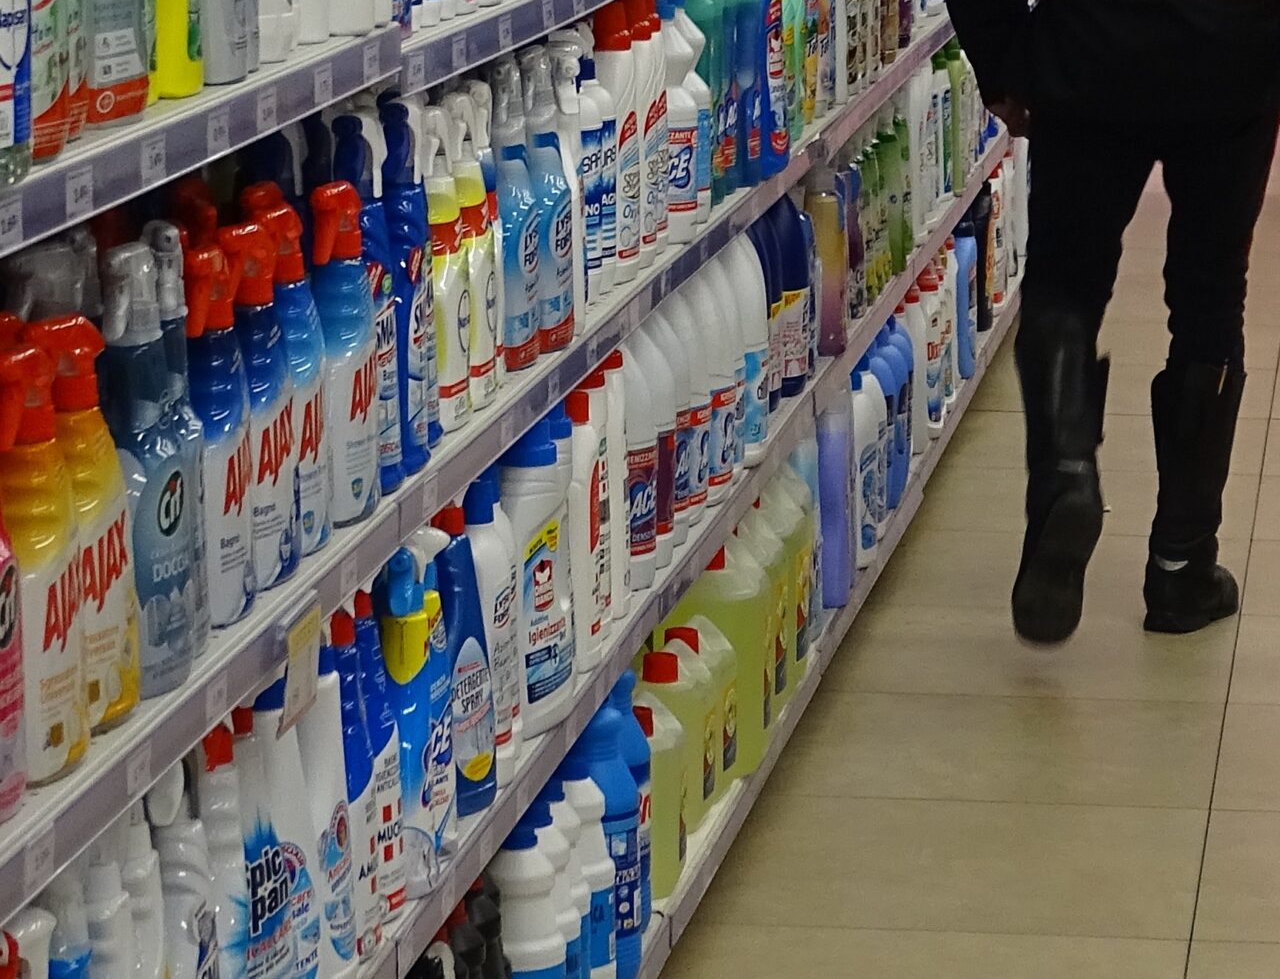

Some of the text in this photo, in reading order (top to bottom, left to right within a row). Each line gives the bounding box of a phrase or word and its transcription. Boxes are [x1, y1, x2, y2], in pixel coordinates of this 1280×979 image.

[668, 151, 692, 182] CE
[257, 395, 296, 487] AJAX
[83, 509, 129, 614] AJAX
[452, 668, 490, 702] DETERGENTE
[461, 689, 484, 714] SPRAY
[249, 845, 284, 898] pic
[251, 875, 290, 937] pan
